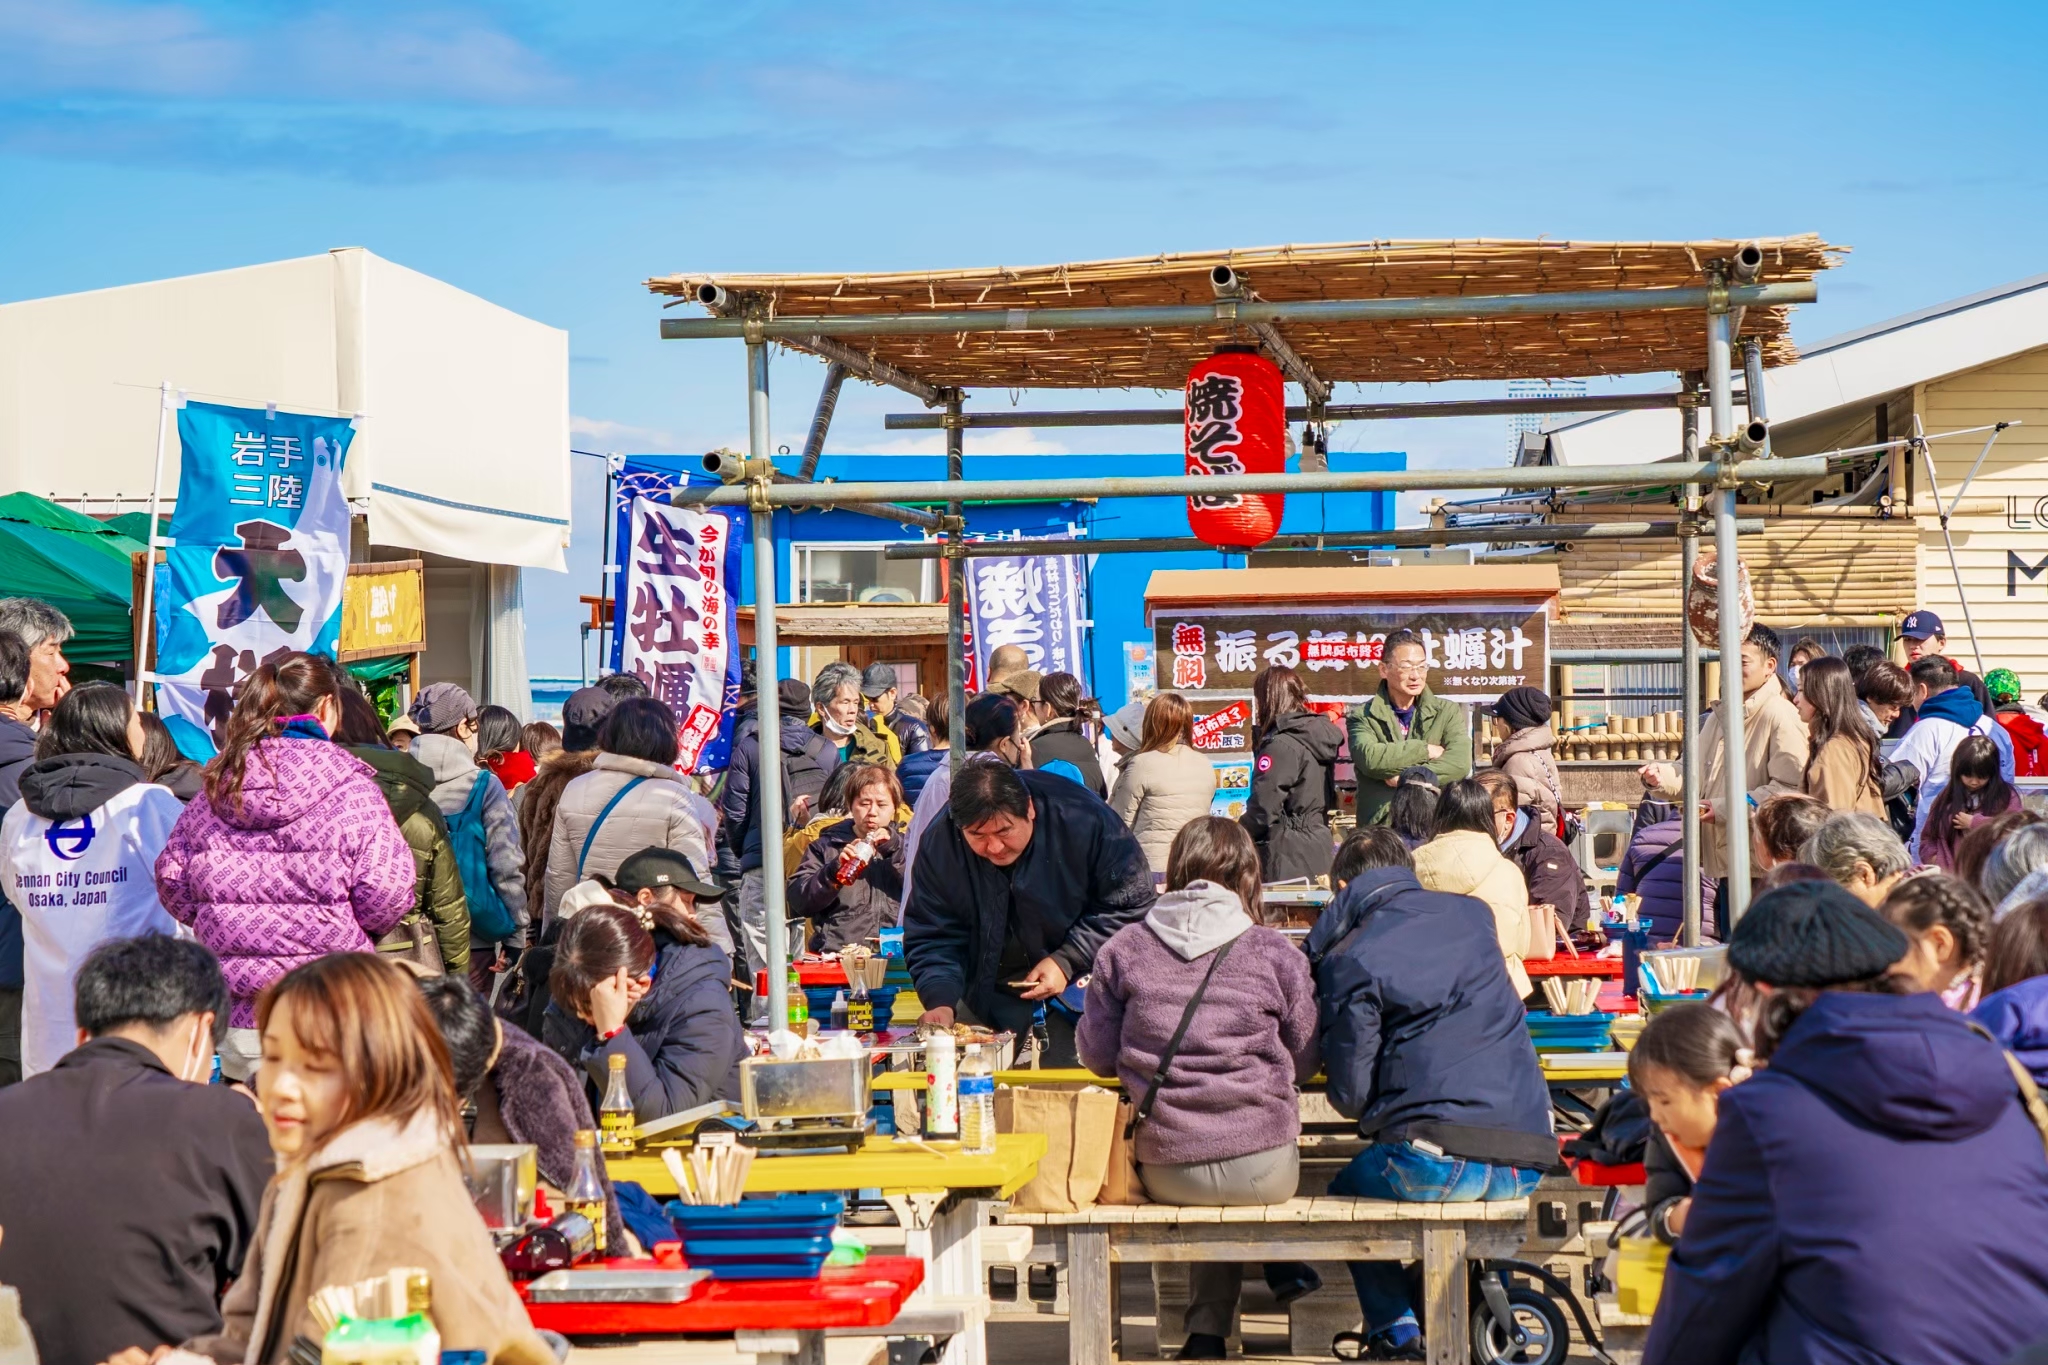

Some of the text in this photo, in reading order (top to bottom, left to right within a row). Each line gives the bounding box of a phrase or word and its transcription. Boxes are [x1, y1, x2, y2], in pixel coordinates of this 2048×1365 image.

[231, 431, 303, 468] 岩手
[230, 473, 303, 509] 三陸
[698, 524, 720, 650] 今が旬の海の幸
[1173, 623, 1206, 688] 無料
[56, 871, 81, 888] City
[85, 867, 127, 886] Council
[29, 891, 107, 907] Osaka, Japan
